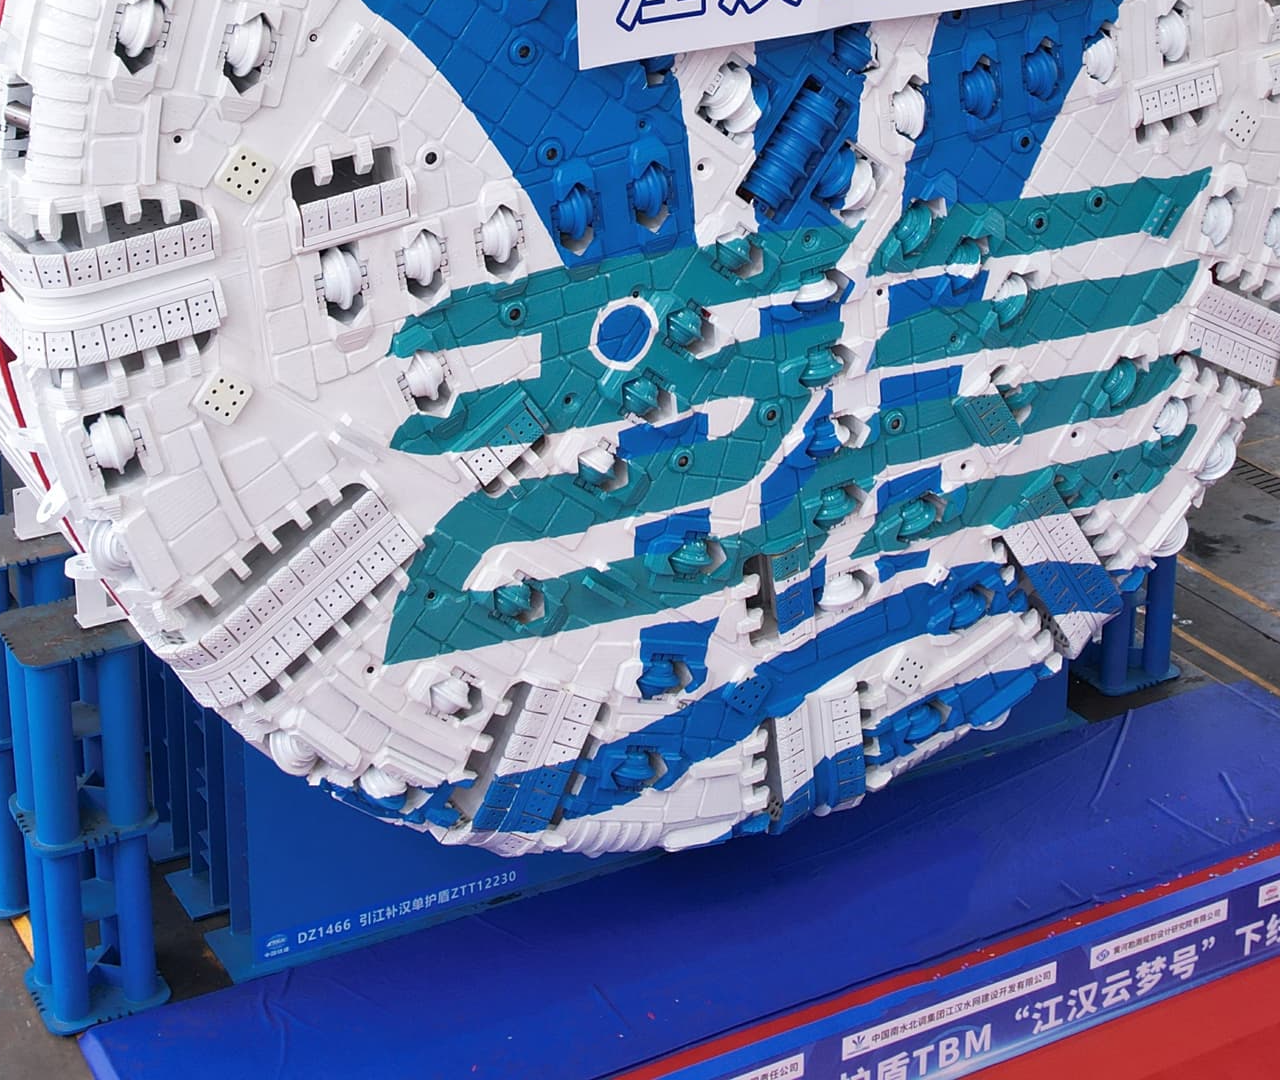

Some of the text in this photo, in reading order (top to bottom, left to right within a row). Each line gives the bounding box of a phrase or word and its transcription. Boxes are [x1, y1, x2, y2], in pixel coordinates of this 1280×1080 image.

[297, 870, 518, 945] DZ1466 引江补汉单护盾ZTT12230
[870, 970, 1053, 1044] 中国南水北调集团江汉水网建设开发有限公司
[1014, 935, 1217, 1035] “江汉云梦号”
